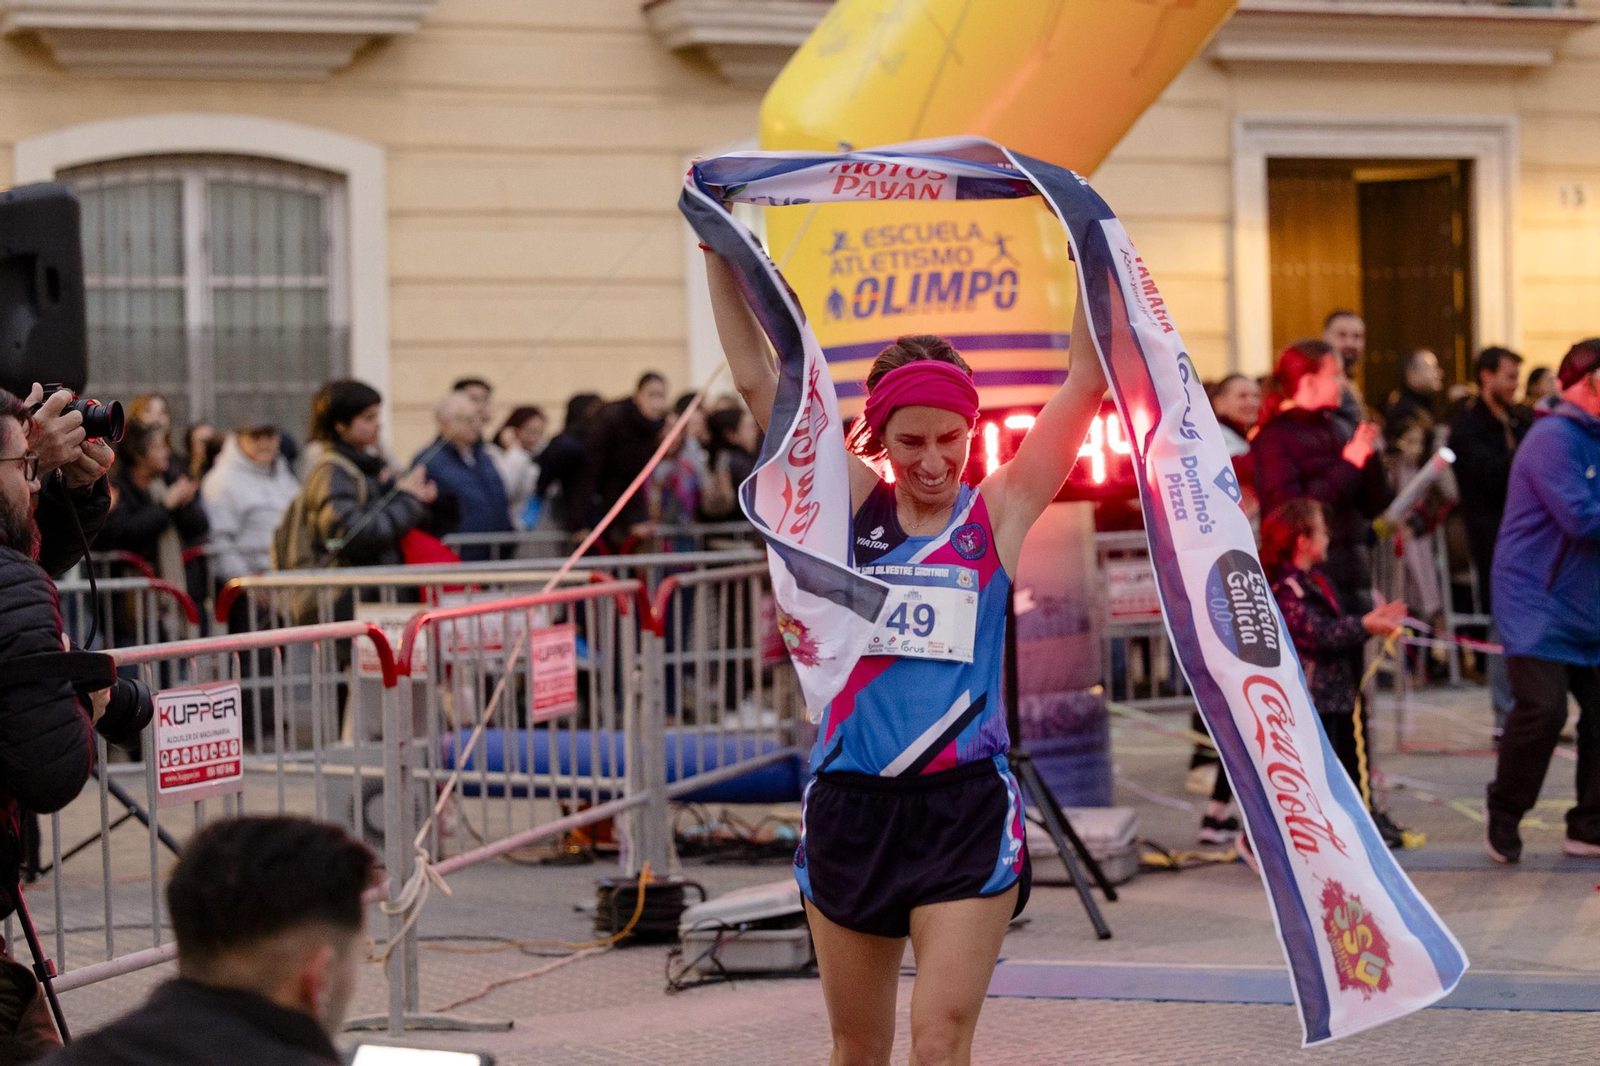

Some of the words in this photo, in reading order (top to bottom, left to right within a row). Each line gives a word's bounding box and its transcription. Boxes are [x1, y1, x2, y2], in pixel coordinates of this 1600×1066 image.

[832, 175, 943, 200] PAYAN
[862, 221, 983, 249] ESCUELA
[830, 246, 974, 279] ATLETISMO
[852, 269, 1018, 320] OLIMPO
[1164, 473, 1189, 522] Pizza
[1180, 455, 1217, 535] Domino's
[856, 536, 890, 551] VIATOR
[875, 565, 913, 576] SILVESTRE
[886, 602, 936, 638] 49
[1226, 571, 1258, 645] Galicia
[1246, 569, 1279, 650] Estrella
[159, 697, 237, 727] KUPPER
